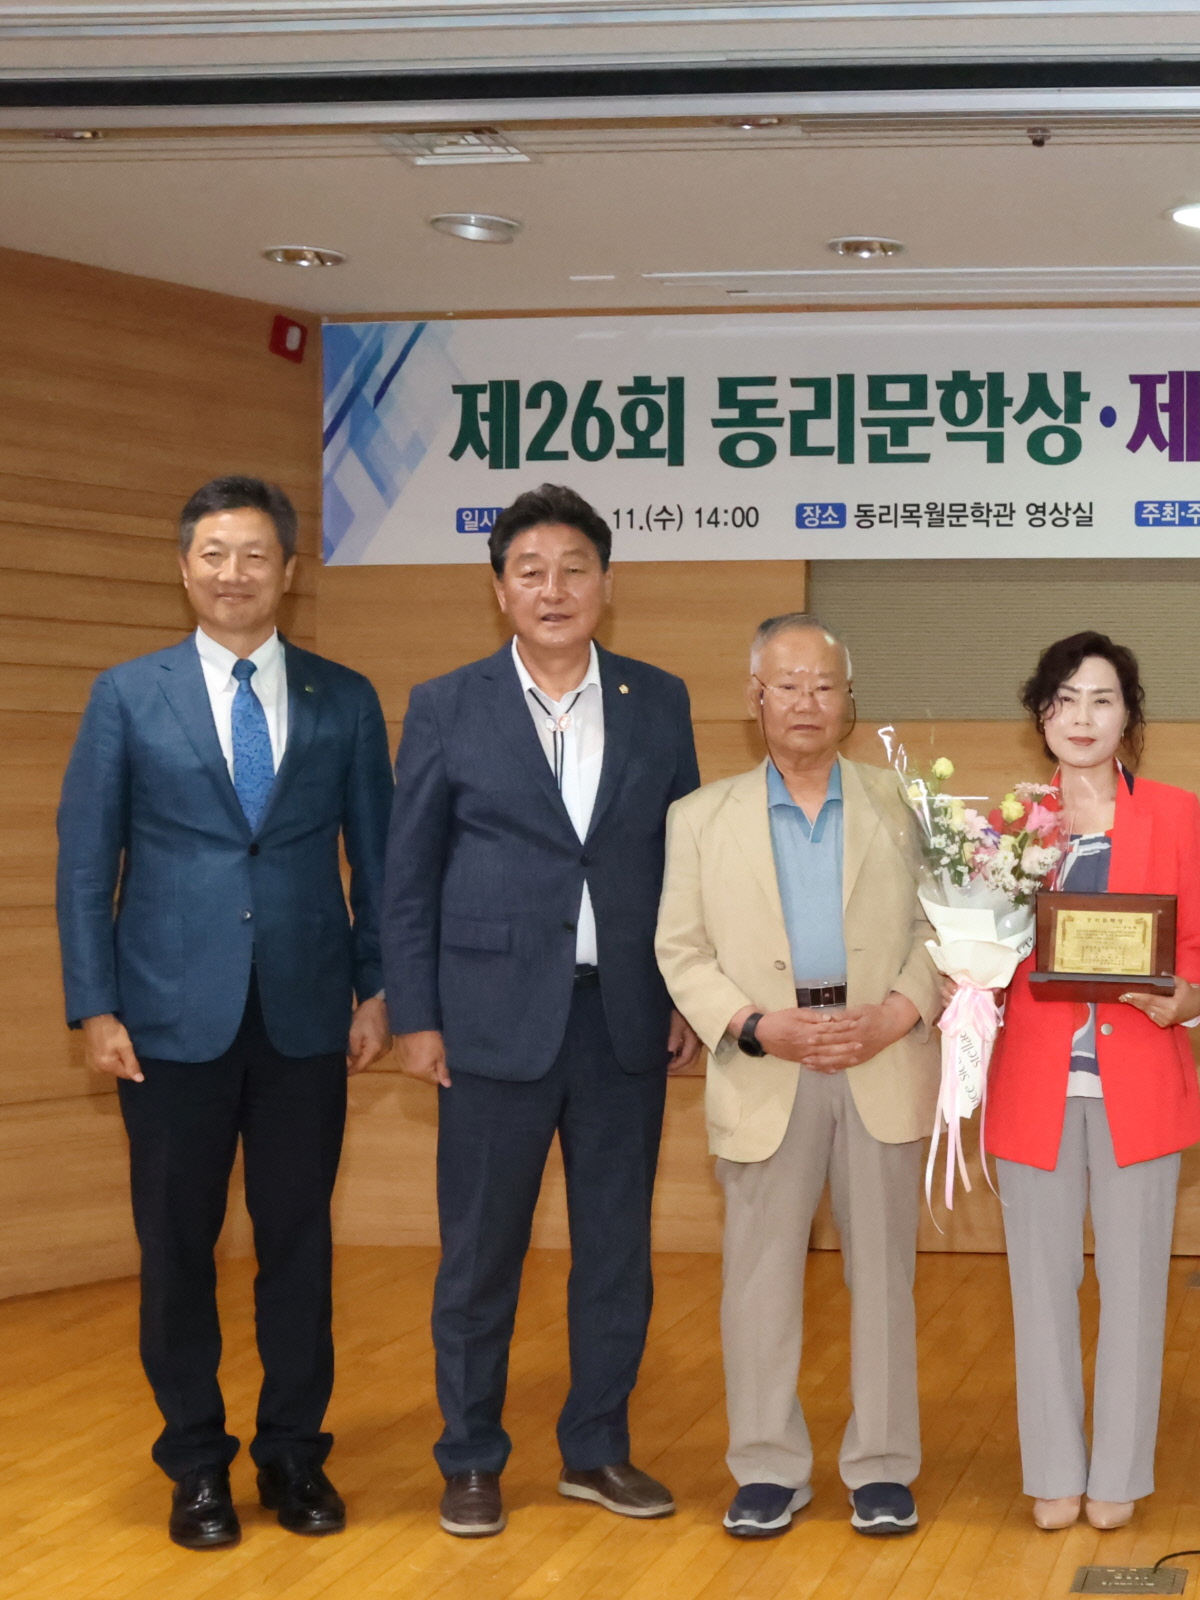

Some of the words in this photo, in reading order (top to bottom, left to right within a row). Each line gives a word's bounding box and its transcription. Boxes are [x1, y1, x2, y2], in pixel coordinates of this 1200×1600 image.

[448, 375, 685, 470] 제26회
[462, 509, 497, 531] 일시
[694, 506, 760, 529] 14:00
[802, 505, 840, 527] 장소
[853, 501, 1016, 529] 동리목월문학관
[1025, 501, 1093, 528] 영상실
